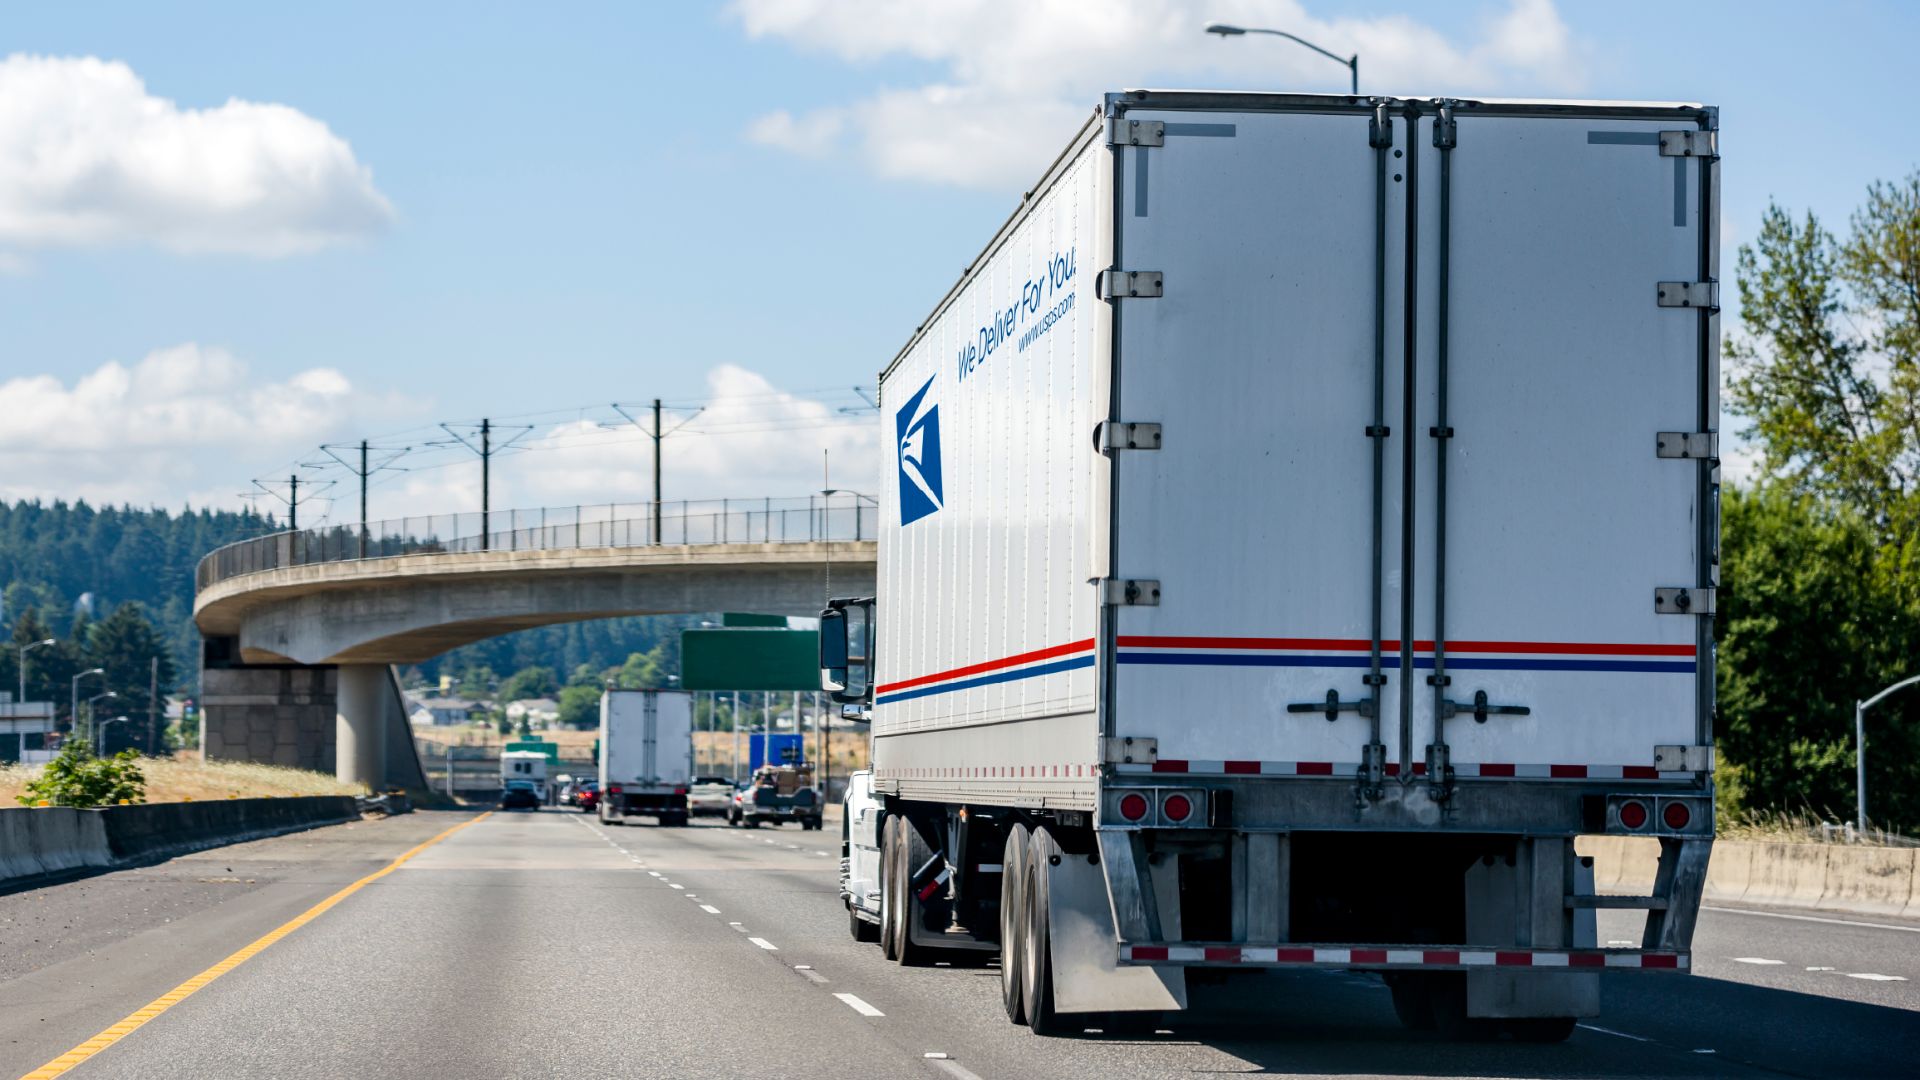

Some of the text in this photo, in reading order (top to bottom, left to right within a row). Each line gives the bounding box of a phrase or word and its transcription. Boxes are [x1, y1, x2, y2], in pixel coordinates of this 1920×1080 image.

[958, 340, 976, 384] We
[978, 300, 1020, 365] Deliver
[1021, 275, 1045, 324] For
[1018, 292, 1076, 354] www.usps.com
